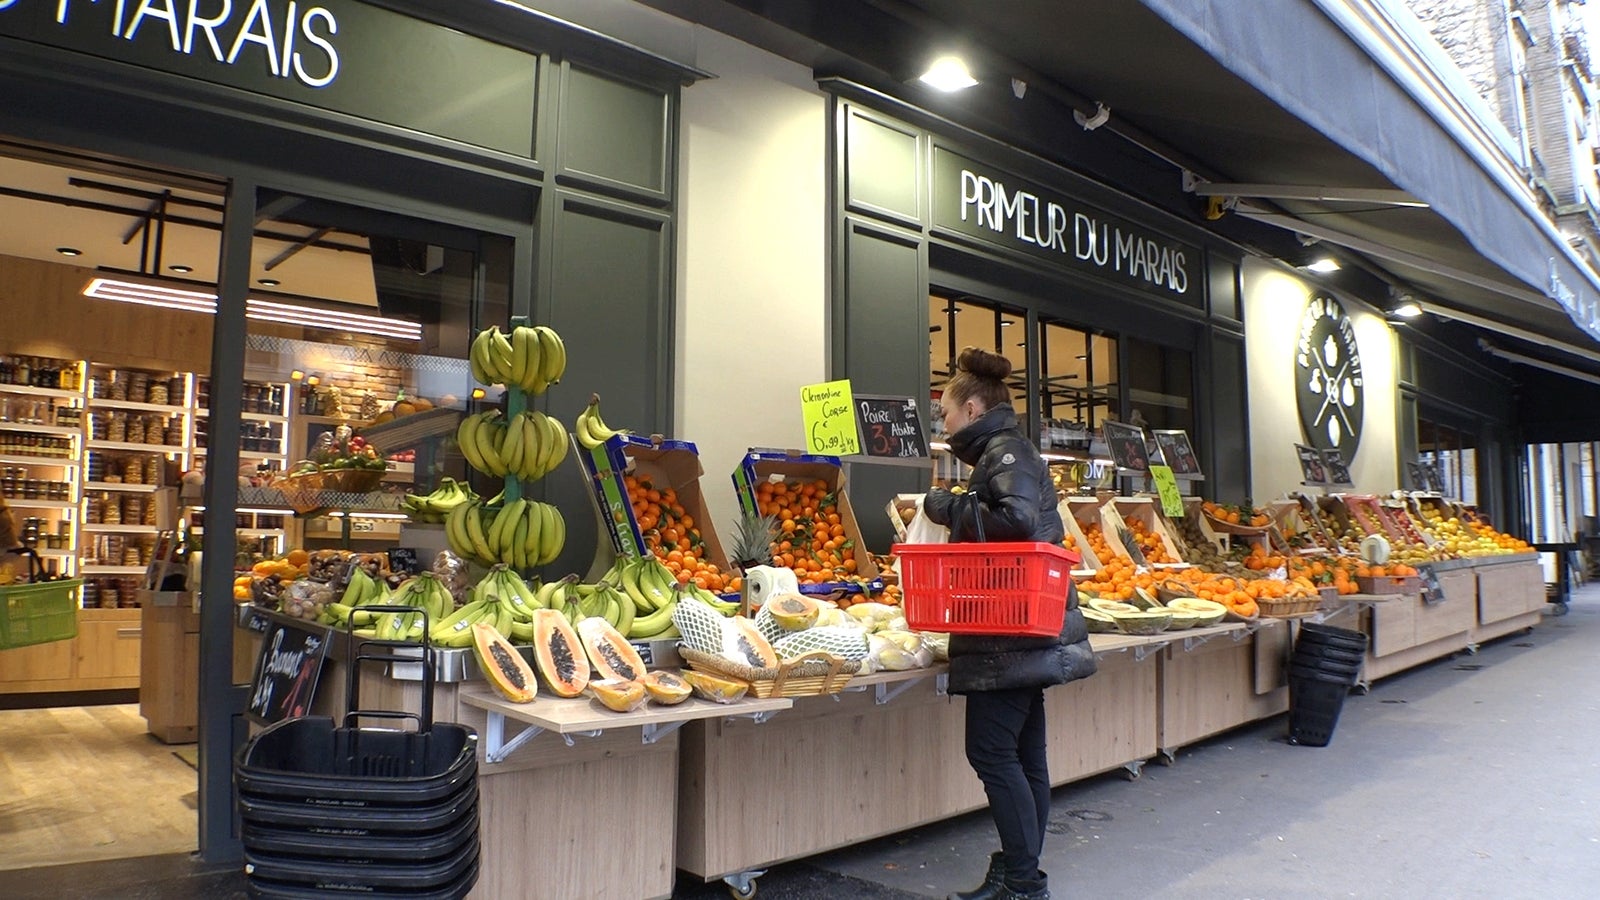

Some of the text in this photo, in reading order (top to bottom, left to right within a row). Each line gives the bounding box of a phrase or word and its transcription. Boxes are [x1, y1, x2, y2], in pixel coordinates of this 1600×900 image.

[961, 169, 1188, 294] PRIMEUR DU MARAIS
